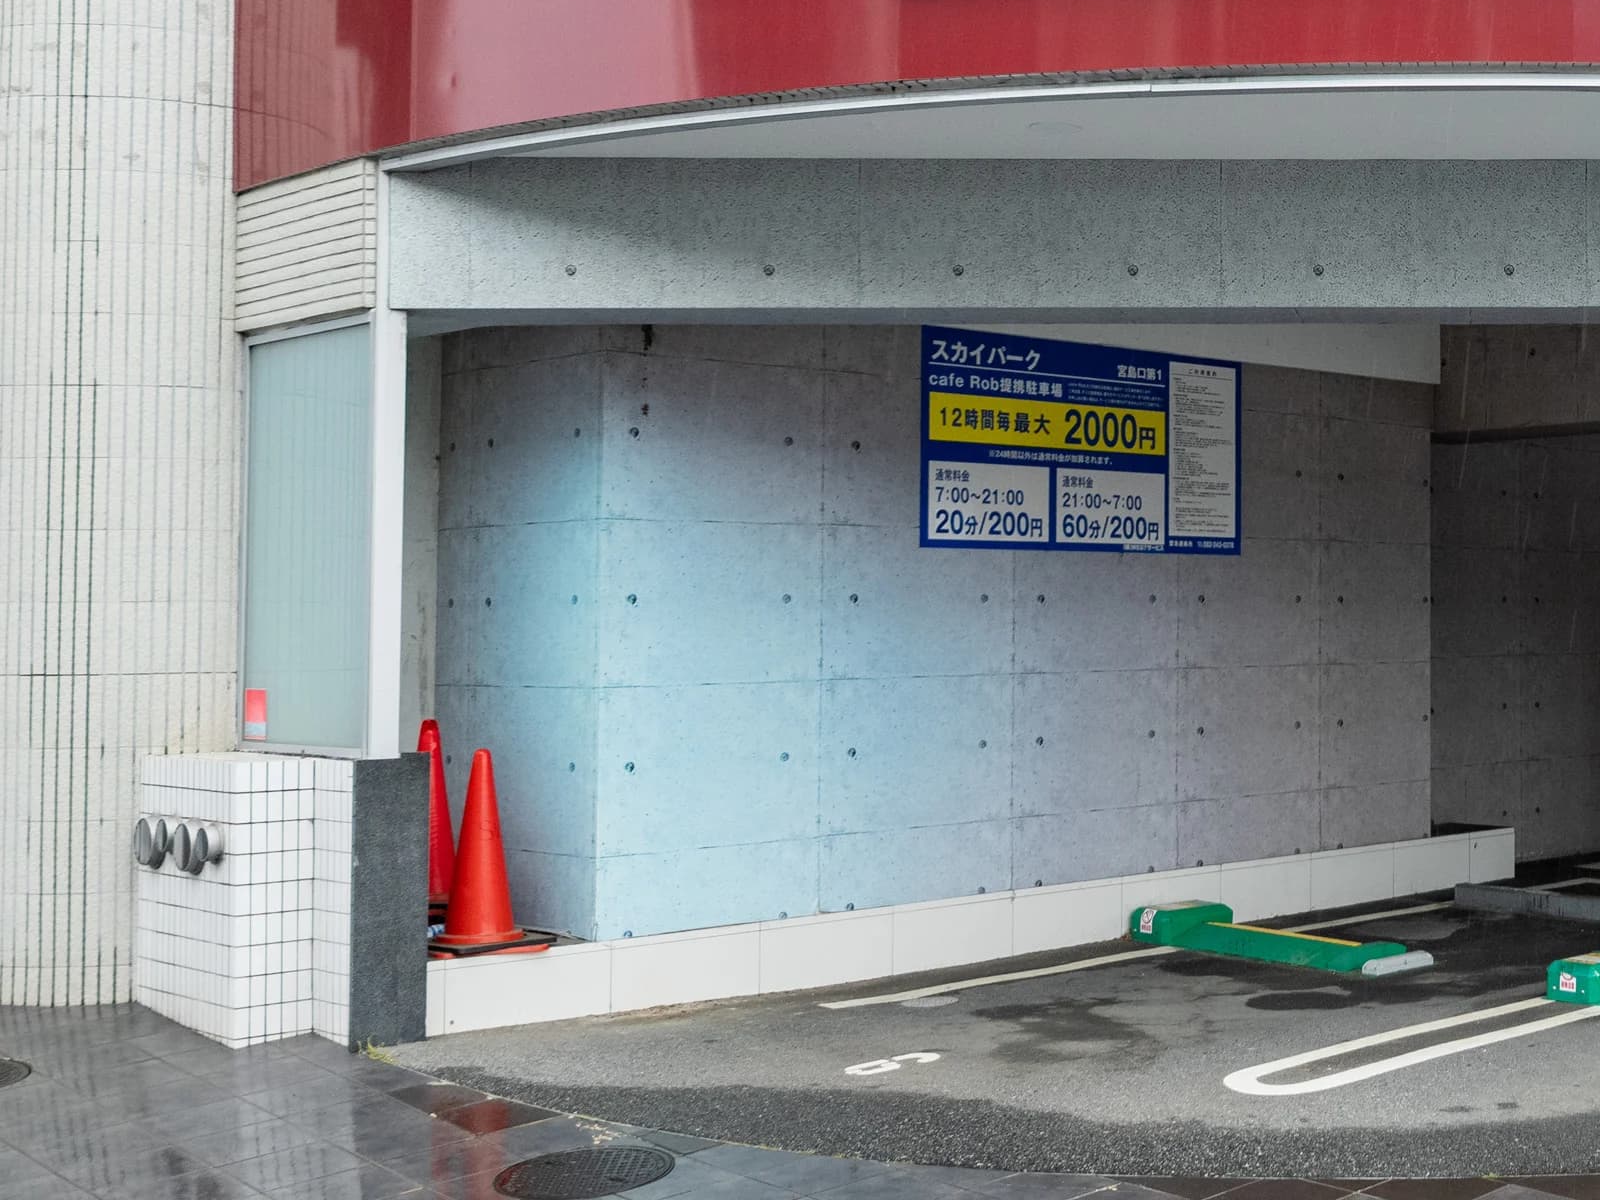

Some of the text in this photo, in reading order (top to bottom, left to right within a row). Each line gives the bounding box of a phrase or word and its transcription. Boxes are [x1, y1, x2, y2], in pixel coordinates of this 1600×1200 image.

[931, 340, 1040, 371] スカイパーク
[929, 373, 964, 388] cafe
[1117, 364, 1163, 381] 宮島口第1
[1064, 409, 1156, 450] 2000円
[935, 468, 970, 482] 通常料金
[1062, 476, 1094, 488] 通常料金
[935, 509, 1043, 538] 20分/200円
[1062, 514, 1159, 541] 60分/200円
